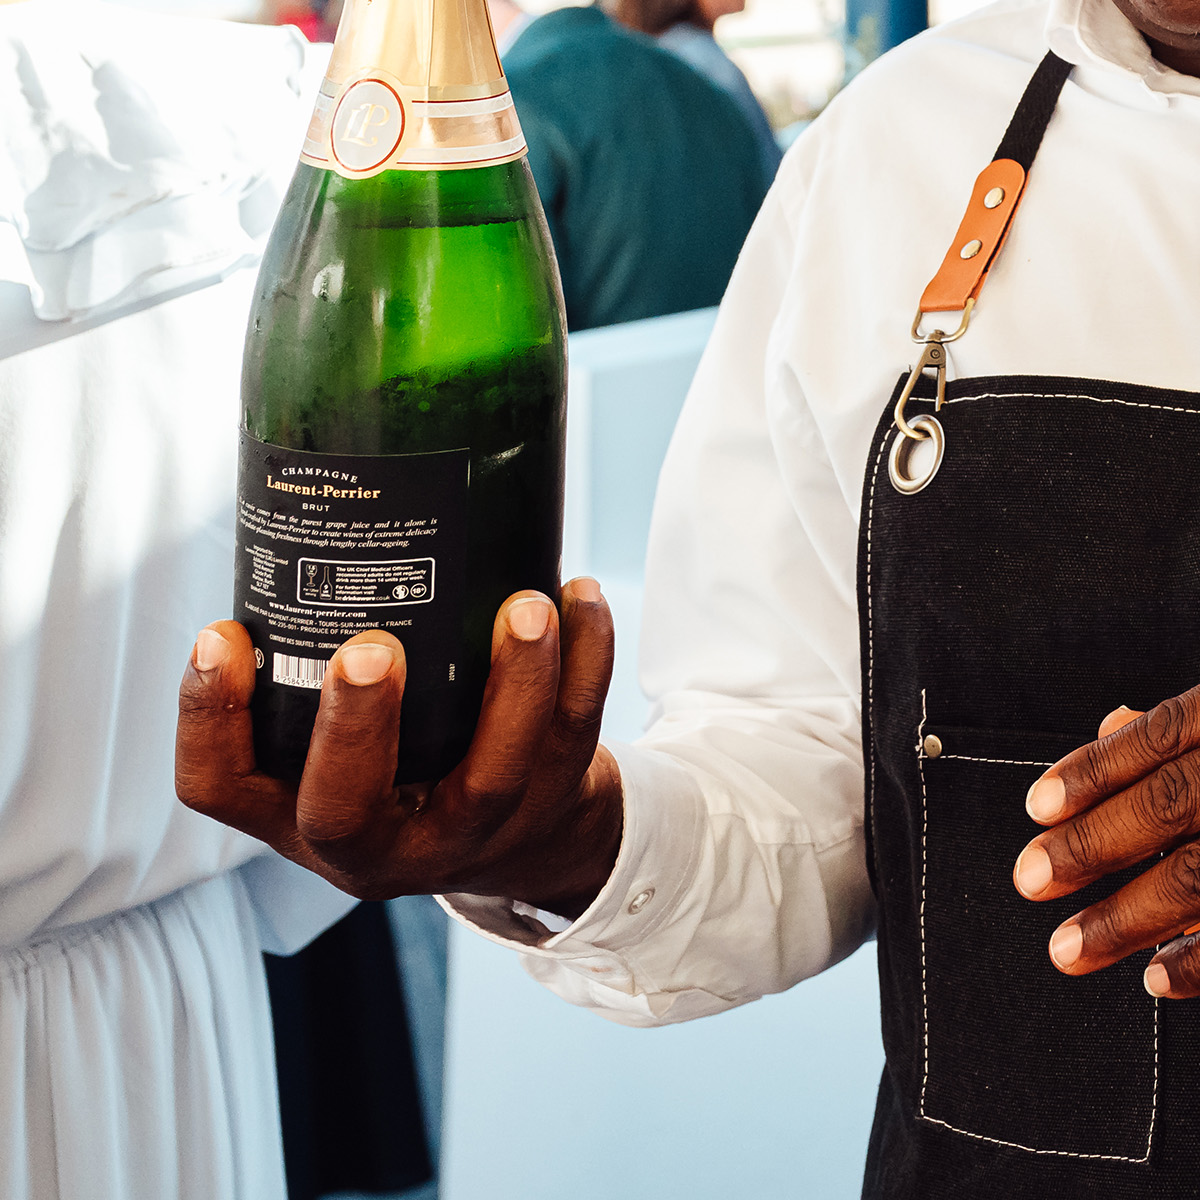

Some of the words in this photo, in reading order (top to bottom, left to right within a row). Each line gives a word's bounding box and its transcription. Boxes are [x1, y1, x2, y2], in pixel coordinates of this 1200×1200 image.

[282, 467, 358, 484] CHAMPAGNE
[266, 474, 381, 499] Laurent-Perrier
[302, 502, 330, 512] BRUT
[256, 508, 271, 518] comes
[272, 512, 286, 521] from
[288, 515, 299, 524] the
[301, 518, 322, 527] purest
[325, 521, 348, 530] grape
[350, 522, 370, 530] juice
[374, 520, 390, 529] and
[404, 520, 427, 528] alone
[267, 520, 311, 536] Laurent-Perrier
[312, 527, 319, 536] to
[320, 529, 342, 538] create
[342, 530, 364, 538] wines
[365, 530, 374, 540] of
[374, 530, 405, 539] extreme
[406, 528, 438, 537] delicacy
[302, 536, 329, 548] through
[330, 539, 357, 550] lengthy
[358, 540, 410, 549] cellar-ageing.
[268, 602, 366, 618] www.laurent-perrier.com
[268, 612, 314, 626] LAURENT-PERRIER
[300, 625, 329, 634] PRODUCE
